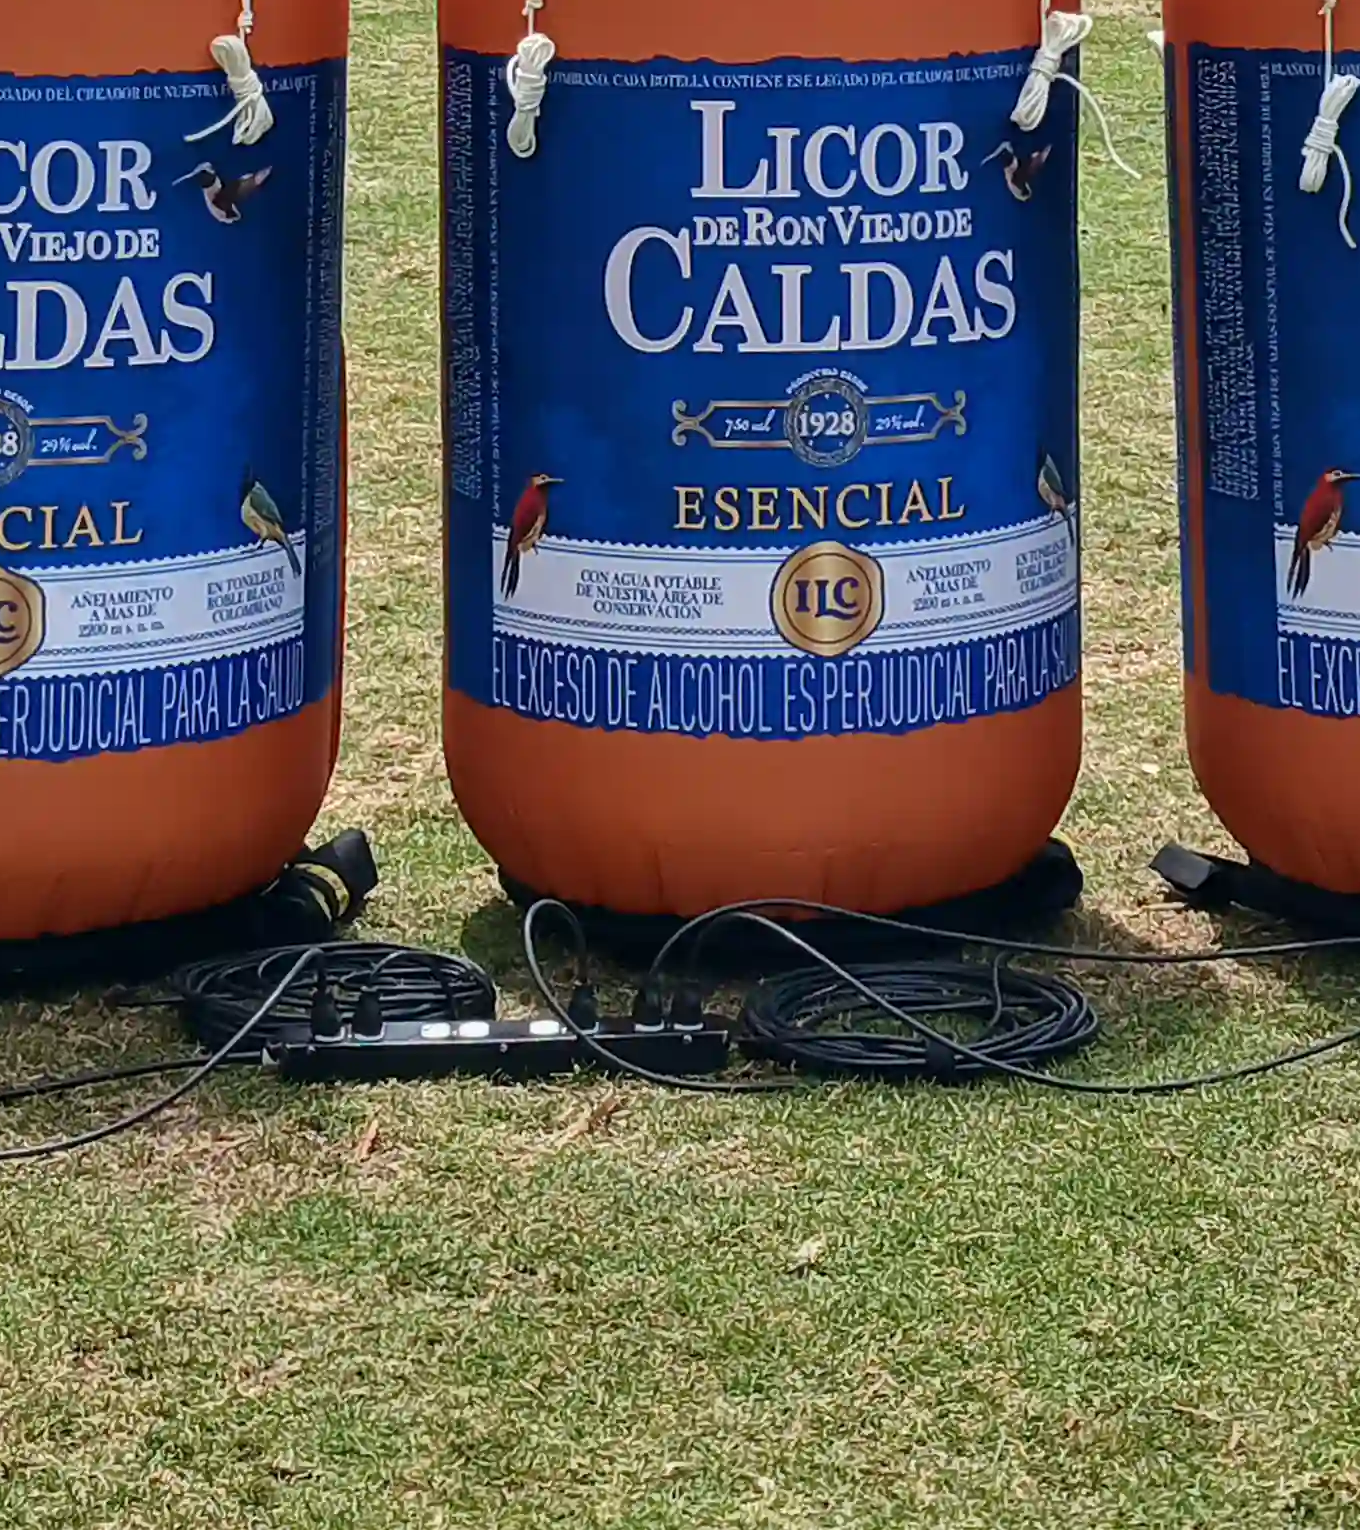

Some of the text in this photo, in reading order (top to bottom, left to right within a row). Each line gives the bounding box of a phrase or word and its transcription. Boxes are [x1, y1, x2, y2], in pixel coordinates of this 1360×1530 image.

[690, 100, 969, 198] LICOR
[115, 228, 159, 259] DE
[694, 205, 972, 247] DE RON VIEJO DE
[604, 225, 1016, 354] CALDAS
[799, 410, 856, 437] 1928
[673, 476, 965, 530] ESENCIAL
[794, 576, 862, 619] ILC
[162, 662, 219, 742] PARA
[227, 655, 250, 728] LA
[257, 639, 305, 721] SALUD
[492, 636, 512, 707] EL
[516, 643, 597, 724] EXCESO
[607, 656, 641, 729] DE
[647, 660, 773, 733] ALCOHOL
[983, 638, 1029, 711] PARA
[1032, 627, 1051, 696] LA
[1277, 636, 1303, 708] EL
